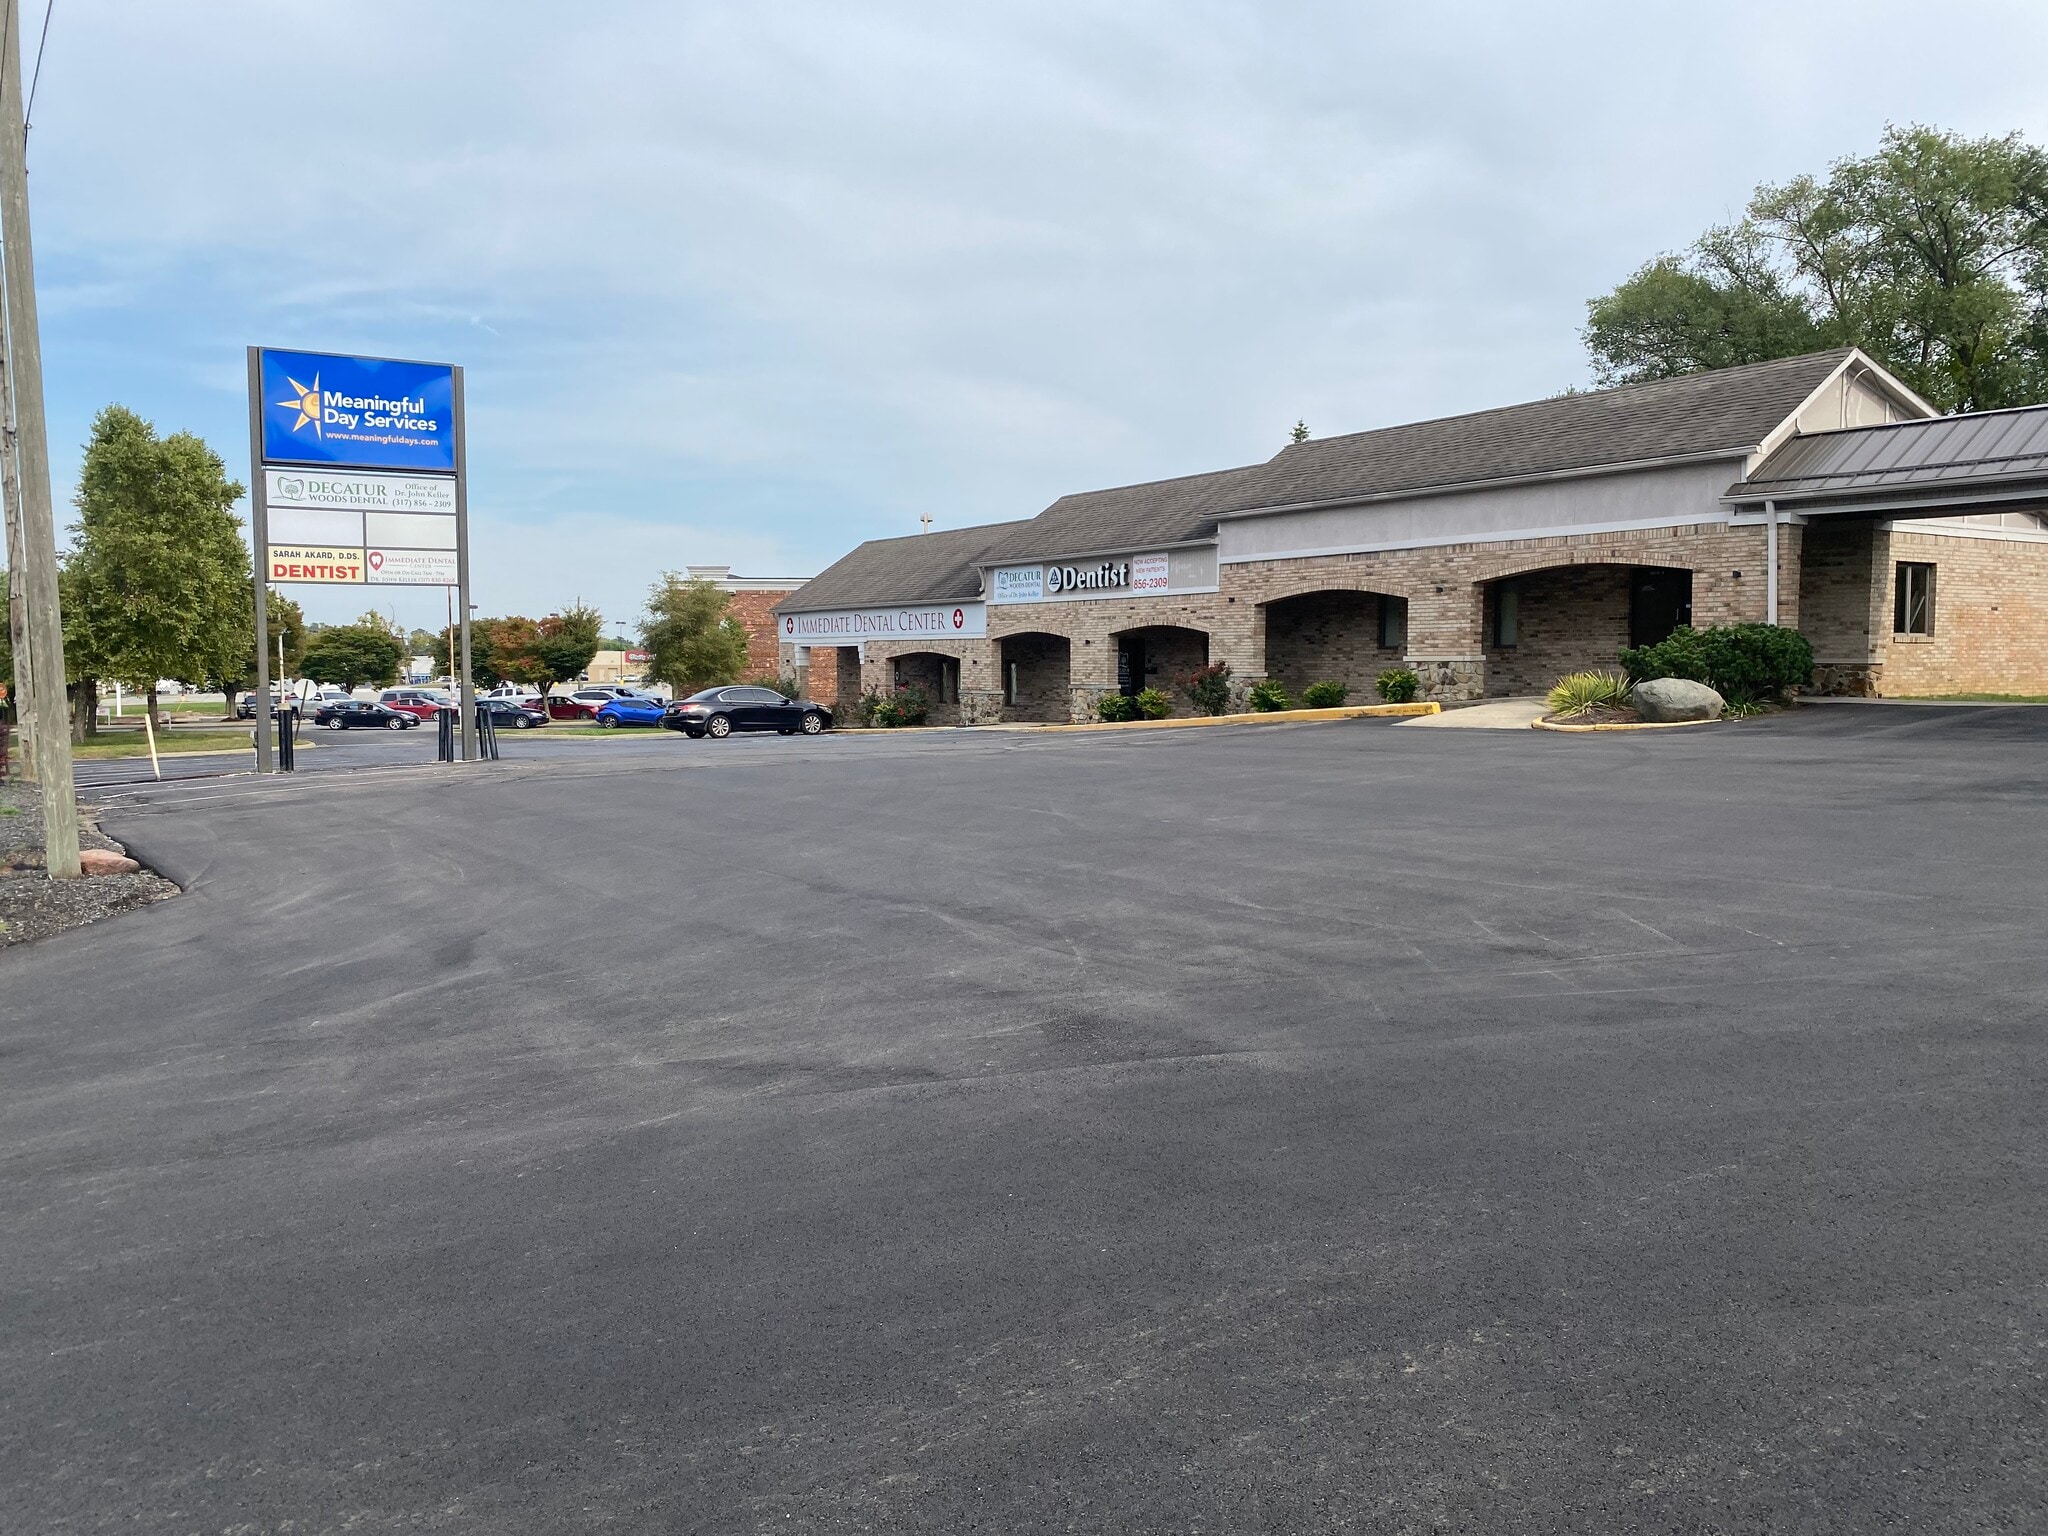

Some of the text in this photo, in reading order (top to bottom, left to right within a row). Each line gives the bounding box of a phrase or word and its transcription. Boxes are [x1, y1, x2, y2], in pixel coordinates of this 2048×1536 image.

[324, 391, 424, 414] Meaningful
[324, 408, 437, 431] Day Services
[326, 432, 439, 447] www.meaningfuldays.com
[308, 481, 387, 497] DECATUR
[405, 483, 427, 491] Office
[309, 494, 389, 505] WOODS DENTAL
[394, 489, 450, 499] Dr. John Keller
[392, 498, 412, 508] (317)
[413, 499, 427, 507] 856
[434, 499, 451, 508] 2309
[273, 550, 301, 558] SARAH
[305, 551, 336, 560] AKARD,
[385, 556, 426, 564] IMMEDIATE
[273, 563, 360, 579] DENTIST
[1009, 571, 1041, 582] DECATUR
[1063, 562, 1128, 590] Dentist
[1133, 577, 1168, 589] 856-2309
[798, 611, 946, 634] IMMEDIATE DENTAL CENTER
